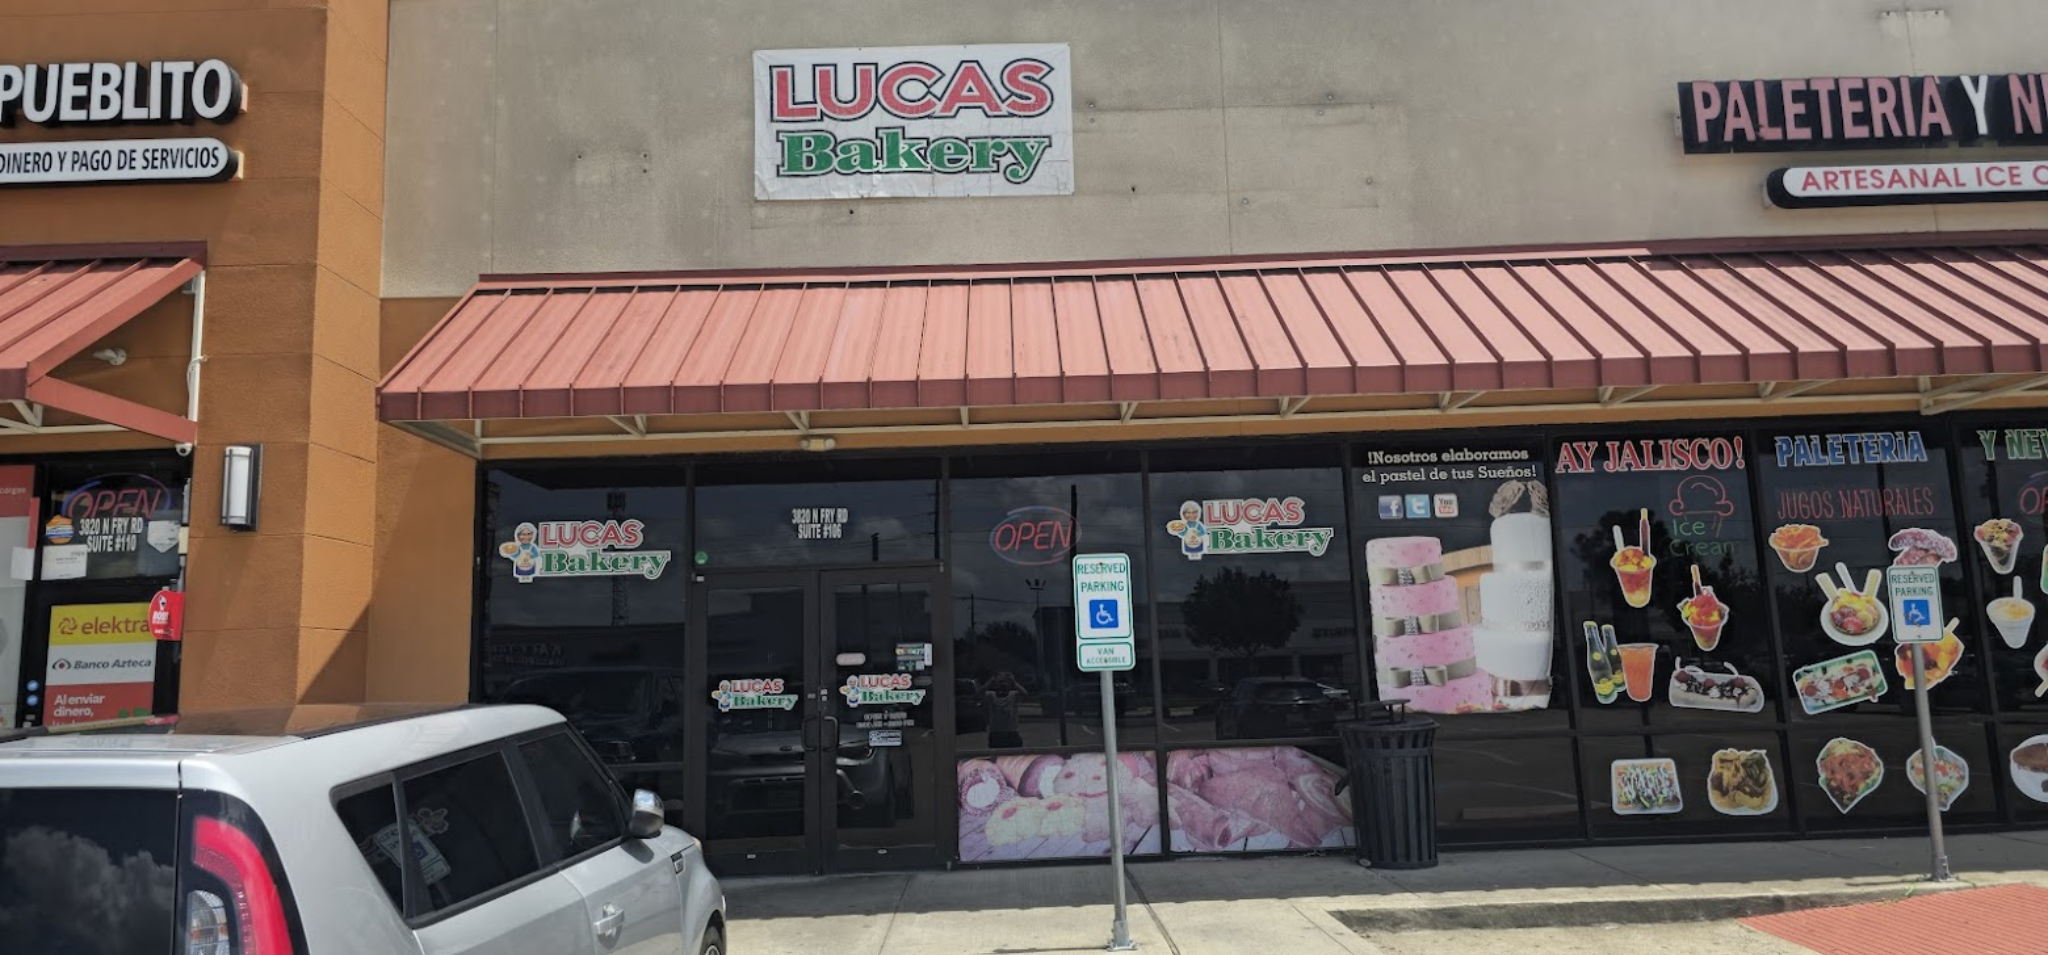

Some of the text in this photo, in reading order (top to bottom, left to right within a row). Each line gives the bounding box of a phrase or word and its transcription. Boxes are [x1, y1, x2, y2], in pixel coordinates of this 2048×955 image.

[0, 59, 232, 123] PUEBLITO
[769, 58, 1054, 122] LUCAS
[1692, 74, 2048, 142] PALETERIA Y N
[58, 150, 67, 172] Y
[71, 149, 112, 172] PAGO
[117, 148, 137, 171] DE
[142, 146, 219, 170] SERVICIOS
[777, 126, 1052, 184] Bakery
[1802, 167, 1967, 191] ARTESANAL
[1976, 165, 2022, 187] ICE
[1441, 448, 1529, 462] elaboramos
[1555, 436, 1746, 473] AY JALISCO!
[1774, 431, 1928, 467] PALETERIA
[1977, 430, 1997, 461] Y
[1362, 464, 1537, 485] el pastel de tus Sueños!
[1205, 499, 1304, 525] LUCAS
[1778, 487, 1934, 519] JUGOS NATURALES
[812, 508, 819, 524] N
[820, 508, 836, 523] FRY
[79, 516, 144, 536] 3820 N FRY RD
[540, 521, 642, 547] LUCAS
[798, 524, 821, 539] SUITE
[995, 520, 1073, 551] OPEN
[1673, 519, 1706, 536] Ice
[86, 534, 137, 553] SUITE #110
[1207, 526, 1332, 554] Bakery
[540, 549, 669, 577] Bakery
[1077, 562, 1126, 575] RESERVED
[1081, 580, 1125, 592] PARKING
[1891, 573, 1935, 584] RESERVED
[1894, 586, 1934, 597] PARKING
[81, 616, 150, 634] elektra
[1097, 647, 1115, 656] VAN
[74, 659, 152, 670] Banco Azteca
[732, 680, 784, 693] LUCAS
[860, 675, 911, 689] LUCAS
[55, 693, 106, 706] Al enviar
[733, 695, 795, 708] Bakery
[861, 689, 923, 703] Bakery
[54, 706, 94, 718] dinero,
